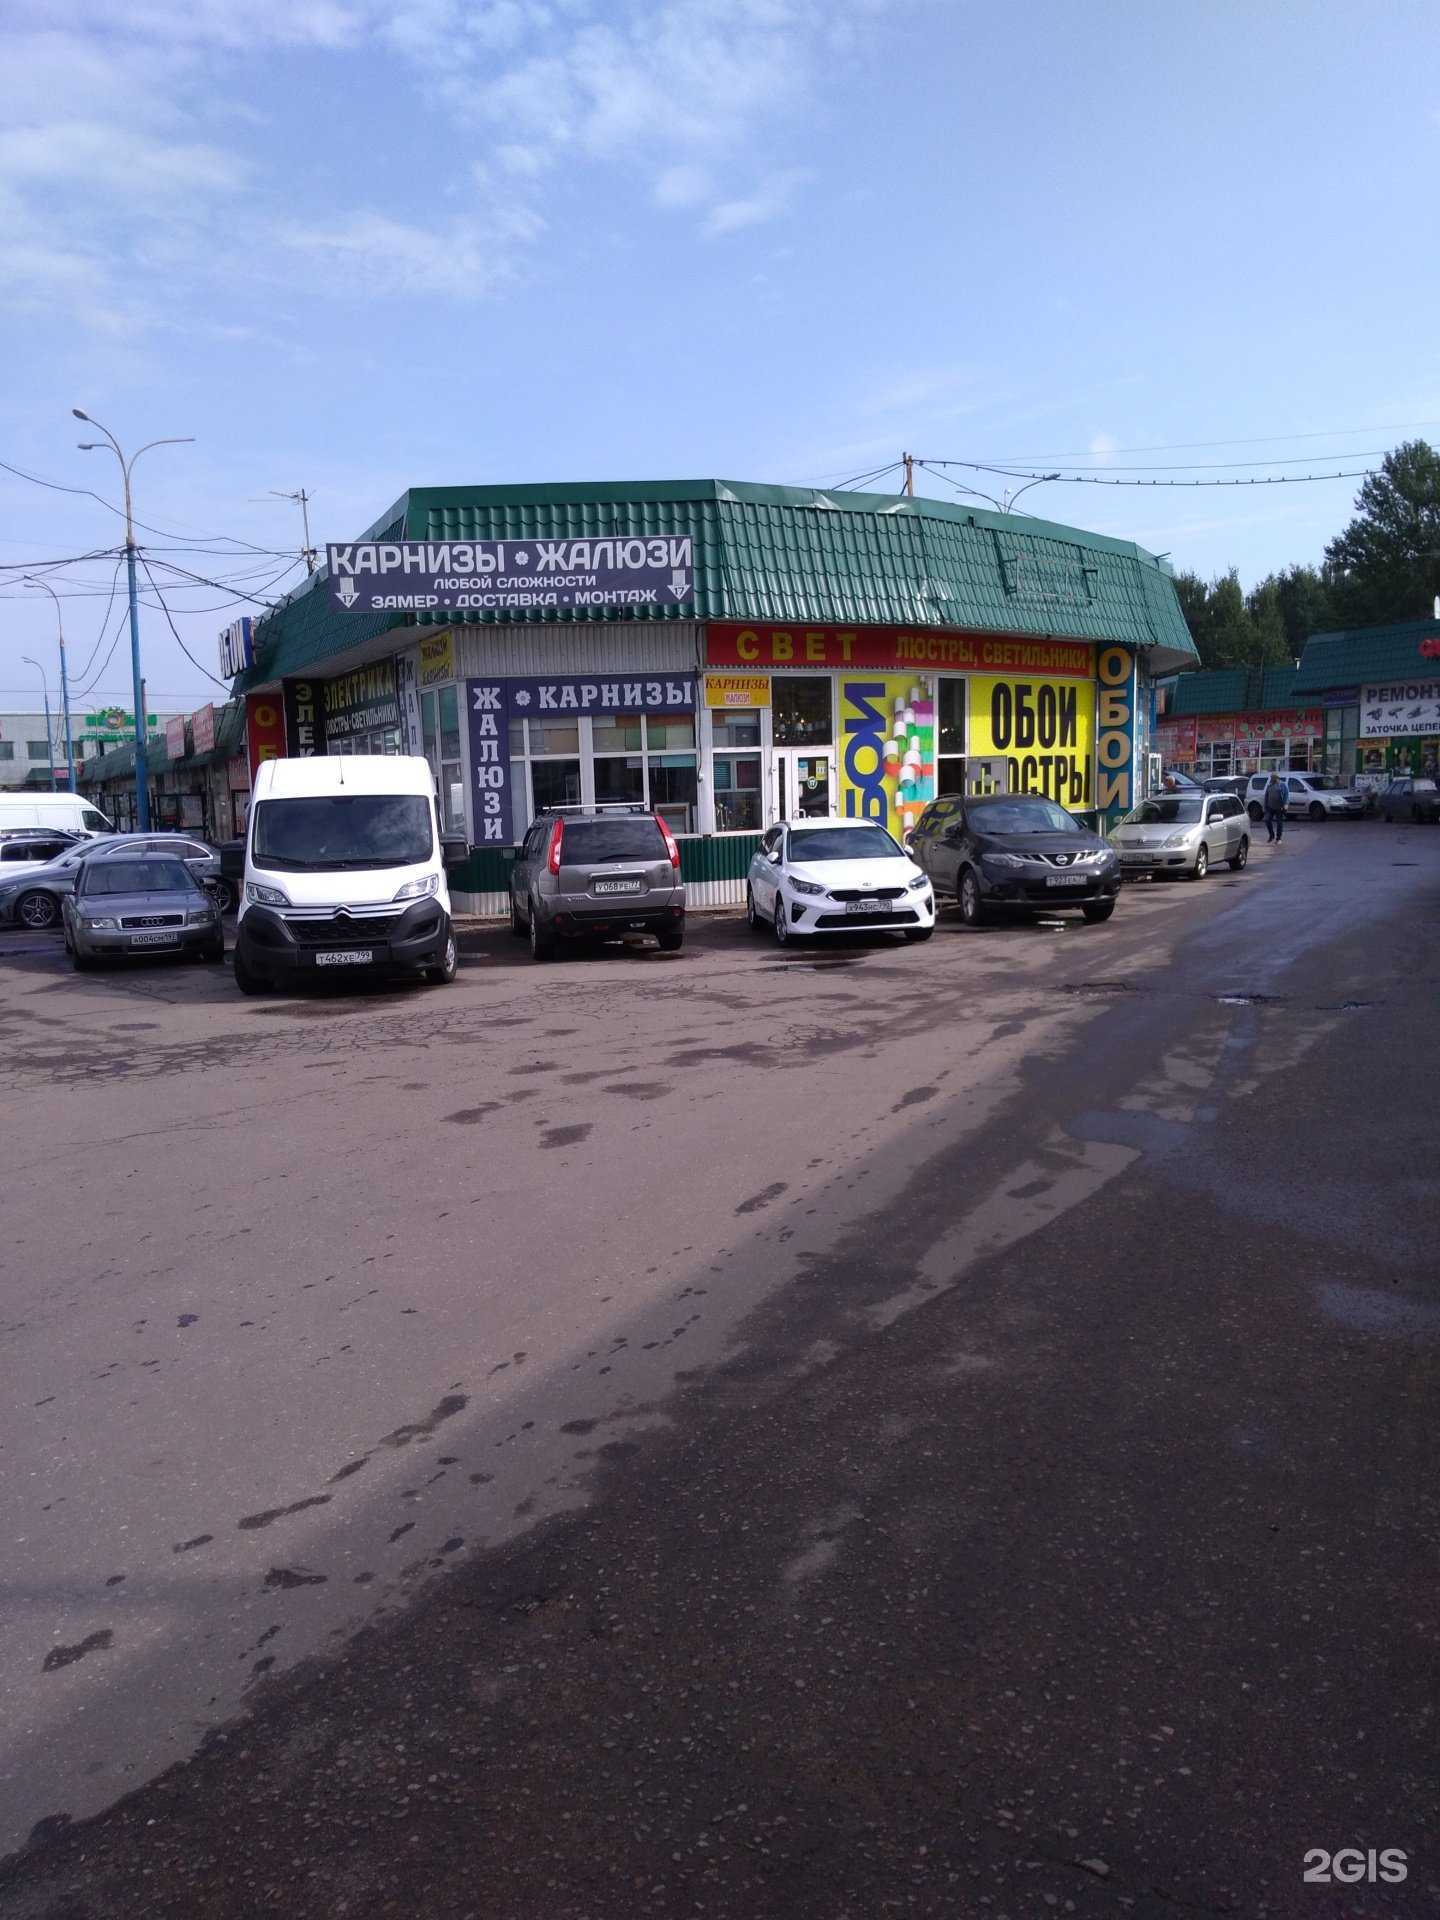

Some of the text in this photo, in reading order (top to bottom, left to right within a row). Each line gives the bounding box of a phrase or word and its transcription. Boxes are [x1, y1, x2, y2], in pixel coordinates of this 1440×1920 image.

[331, 538, 692, 575] КАРНИЗЫ ЖАЛЮЗИ
[433, 575, 597, 590] ЛЮБОЙ СЛОЖНОСТИ
[674, 587, 685, 596] 17
[371, 588, 657, 609] ЗАМЕР ДОСТАВКА МОНТАЖ
[736, 630, 857, 662] СВЕТ
[896, 636, 1087, 669] ЛЮСТРЫ, СВЕТИЛЬНИКИ
[323, 663, 394, 712] ЭЛЕКТРИКА
[538, 681, 693, 709] КАРНИЗЫ
[705, 678, 770, 690] КАРНИЗЫ
[351, 702, 398, 729] СВЕТИЛЬНИКИ
[990, 682, 1077, 751] ОБОИ
[1098, 647, 1132, 809] ОБОИ
[1366, 722, 1440, 734] ЗАТОЧКА ЦЕПЕ
[472, 687, 504, 840] ЖАЛЮЗИ
